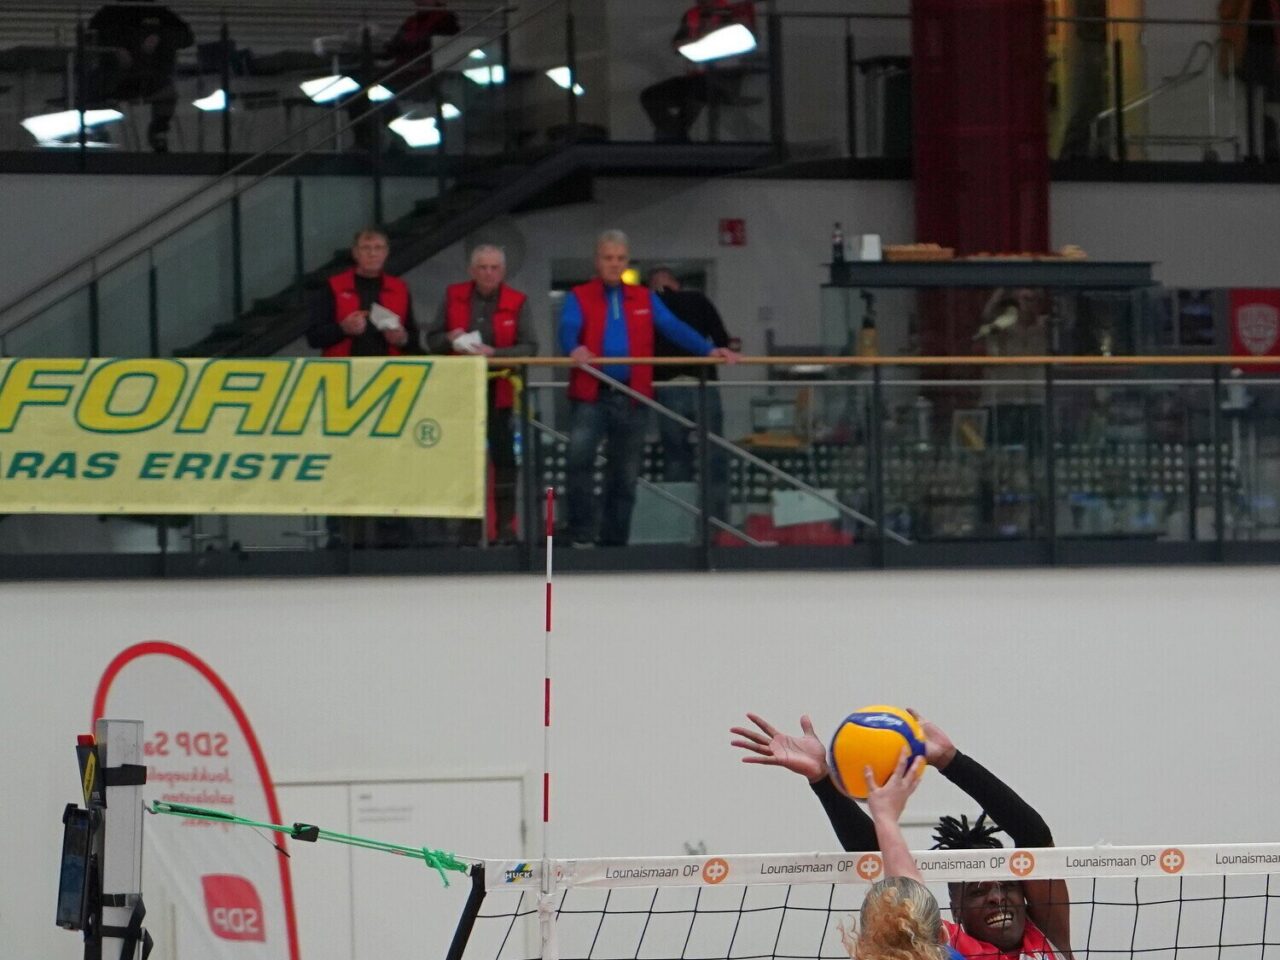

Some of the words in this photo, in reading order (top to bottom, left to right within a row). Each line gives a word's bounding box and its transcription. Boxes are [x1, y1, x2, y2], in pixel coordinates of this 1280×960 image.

[1, 452, 119, 480] RAS
[138, 453, 332, 482] ERISTE
[760, 861, 834, 875] Lounaismaan
[837, 860, 853, 873] OP
[987, 856, 1006, 870] OP
[1066, 854, 1138, 869] Lounaismaan
[1141, 854, 1156, 867] OP
[605, 863, 679, 879] Lounaismaan
[682, 864, 699, 877] OP
